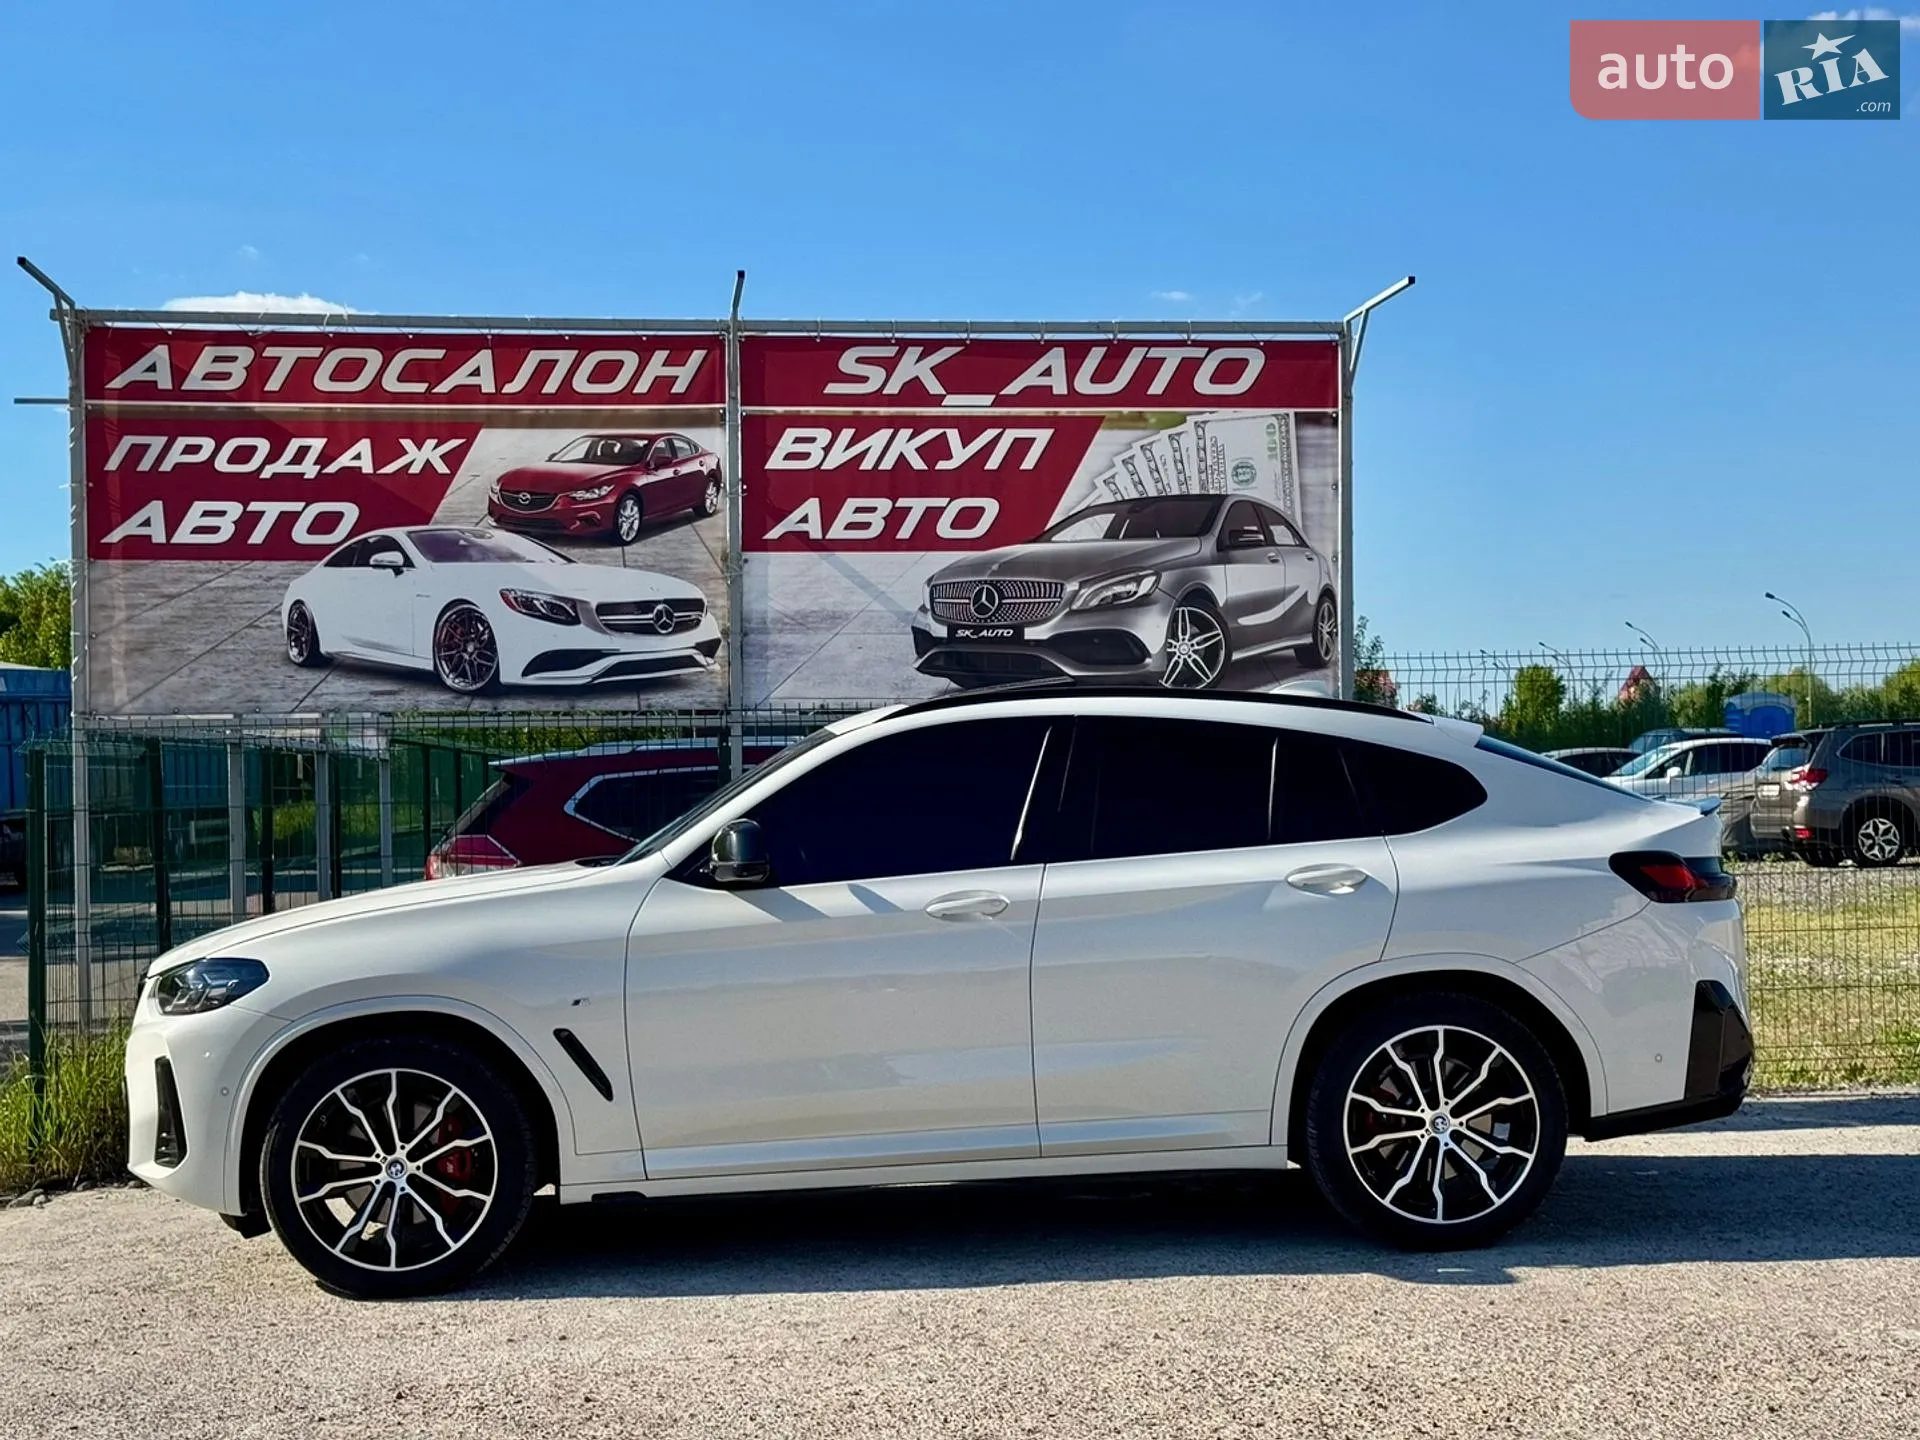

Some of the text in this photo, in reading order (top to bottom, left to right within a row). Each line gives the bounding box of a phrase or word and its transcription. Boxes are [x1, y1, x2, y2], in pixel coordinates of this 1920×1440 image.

[105, 343, 708, 395] АВТОСАЛОН
[822, 345, 1266, 407] SK_AUTO
[103, 434, 468, 479] ПРОДАЖ
[763, 426, 1056, 471] ВИКУП
[100, 499, 361, 545] АВТО
[762, 496, 1001, 540] АВТО
[955, 628, 1014, 639] SK_AUTO
